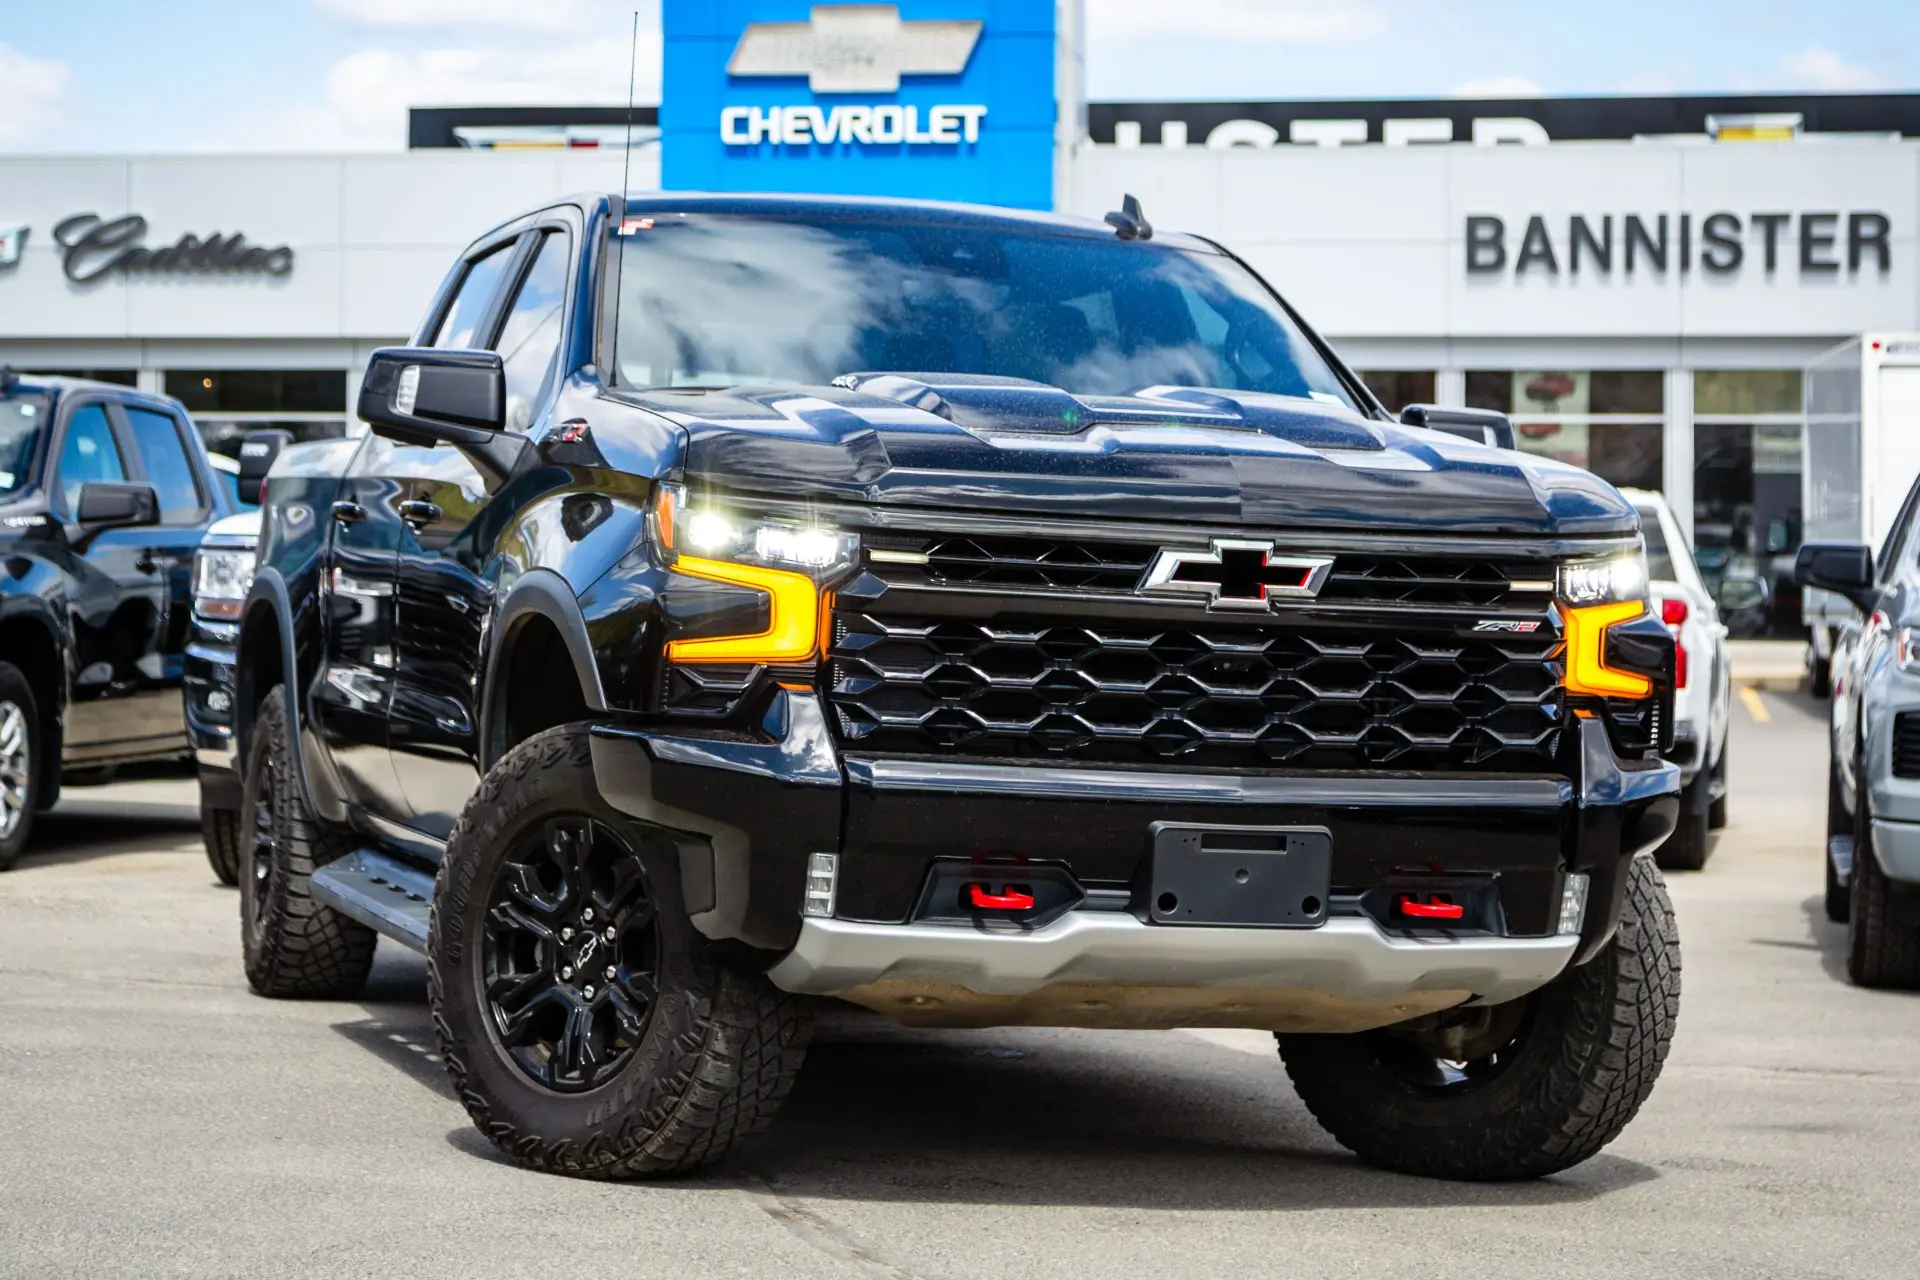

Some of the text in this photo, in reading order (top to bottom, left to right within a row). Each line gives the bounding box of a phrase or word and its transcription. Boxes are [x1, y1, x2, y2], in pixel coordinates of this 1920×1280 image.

[720, 105, 987, 147] CHEVROLET
[1465, 212, 1892, 275] BANNISTER
[1472, 619, 1542, 633] ZR2
